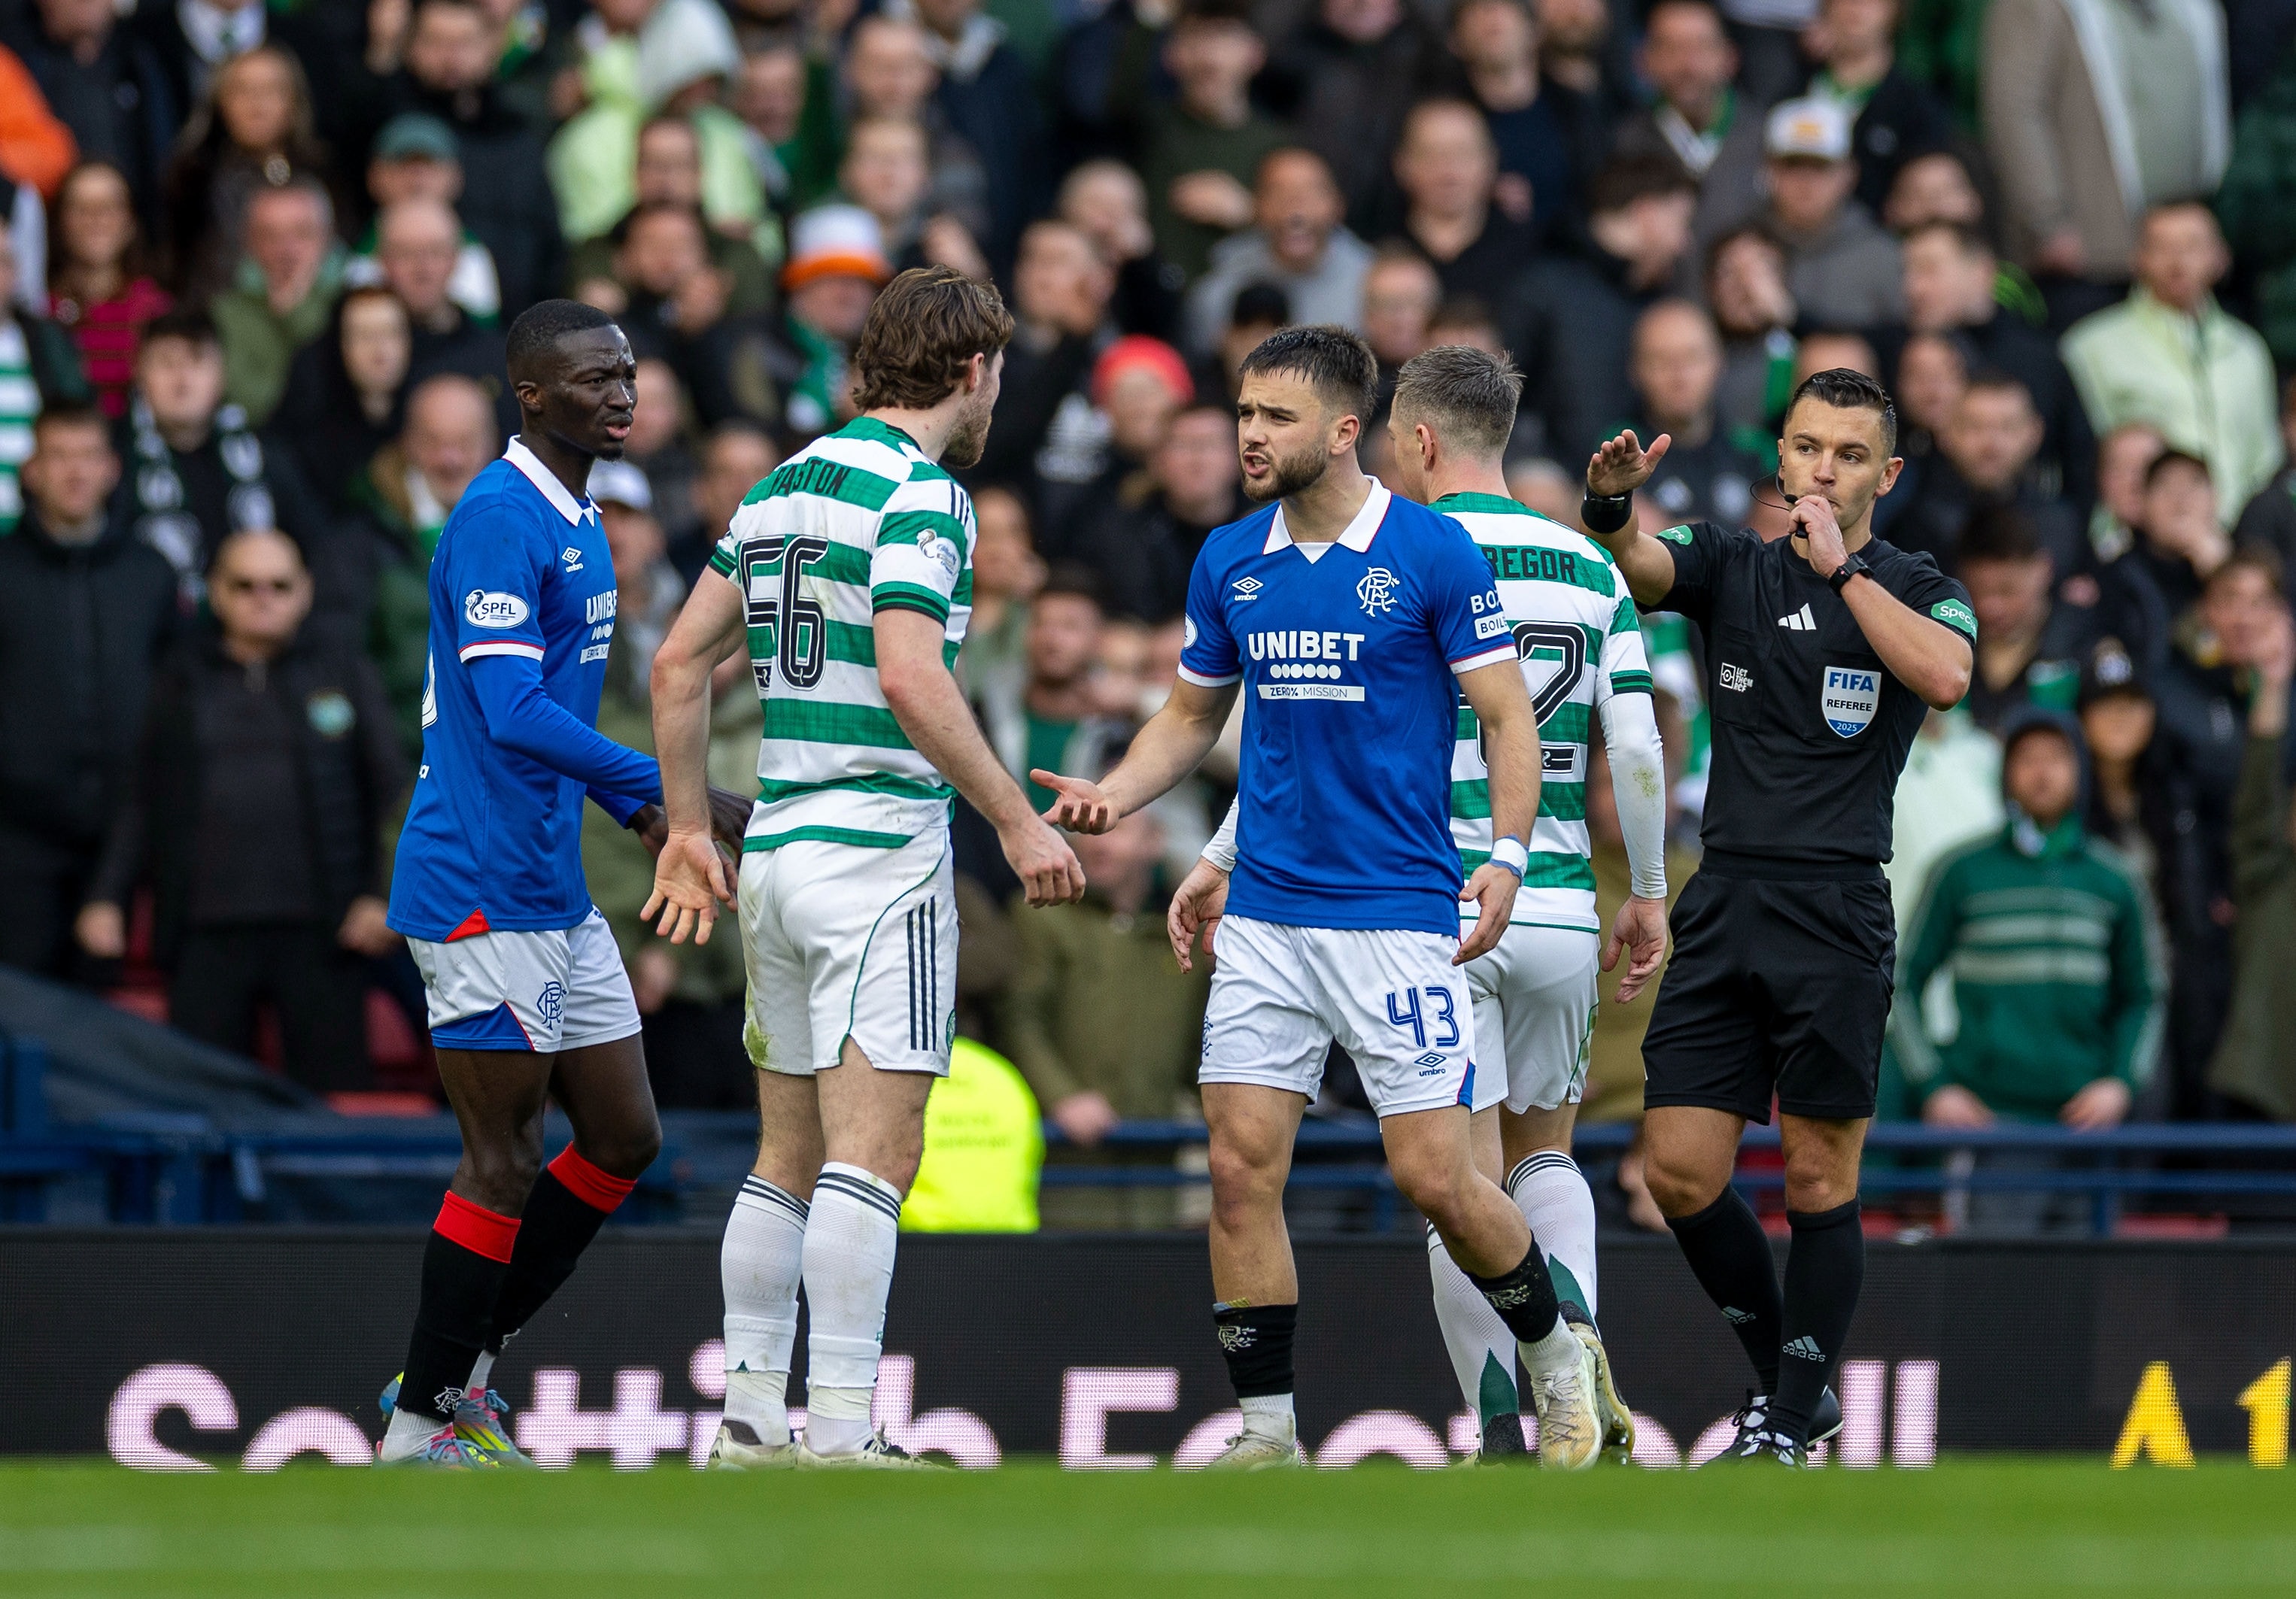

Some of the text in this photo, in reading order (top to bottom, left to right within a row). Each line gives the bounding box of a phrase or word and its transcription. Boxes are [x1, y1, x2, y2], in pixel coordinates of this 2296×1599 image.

[481, 602, 516, 614] SPFL
[739, 535, 828, 691] 56
[1248, 630, 1365, 661] UNIBET
[1829, 672, 1874, 692] FIFA
[1270, 687, 1347, 698] ZERO% MISSION
[1827, 699, 1872, 712] REFEREE
[1836, 723, 1857, 732] 2025
[1386, 987, 1459, 1048] 43
[1419, 1068, 1447, 1076] umbro
[1782, 1345, 1827, 1362] adidas
